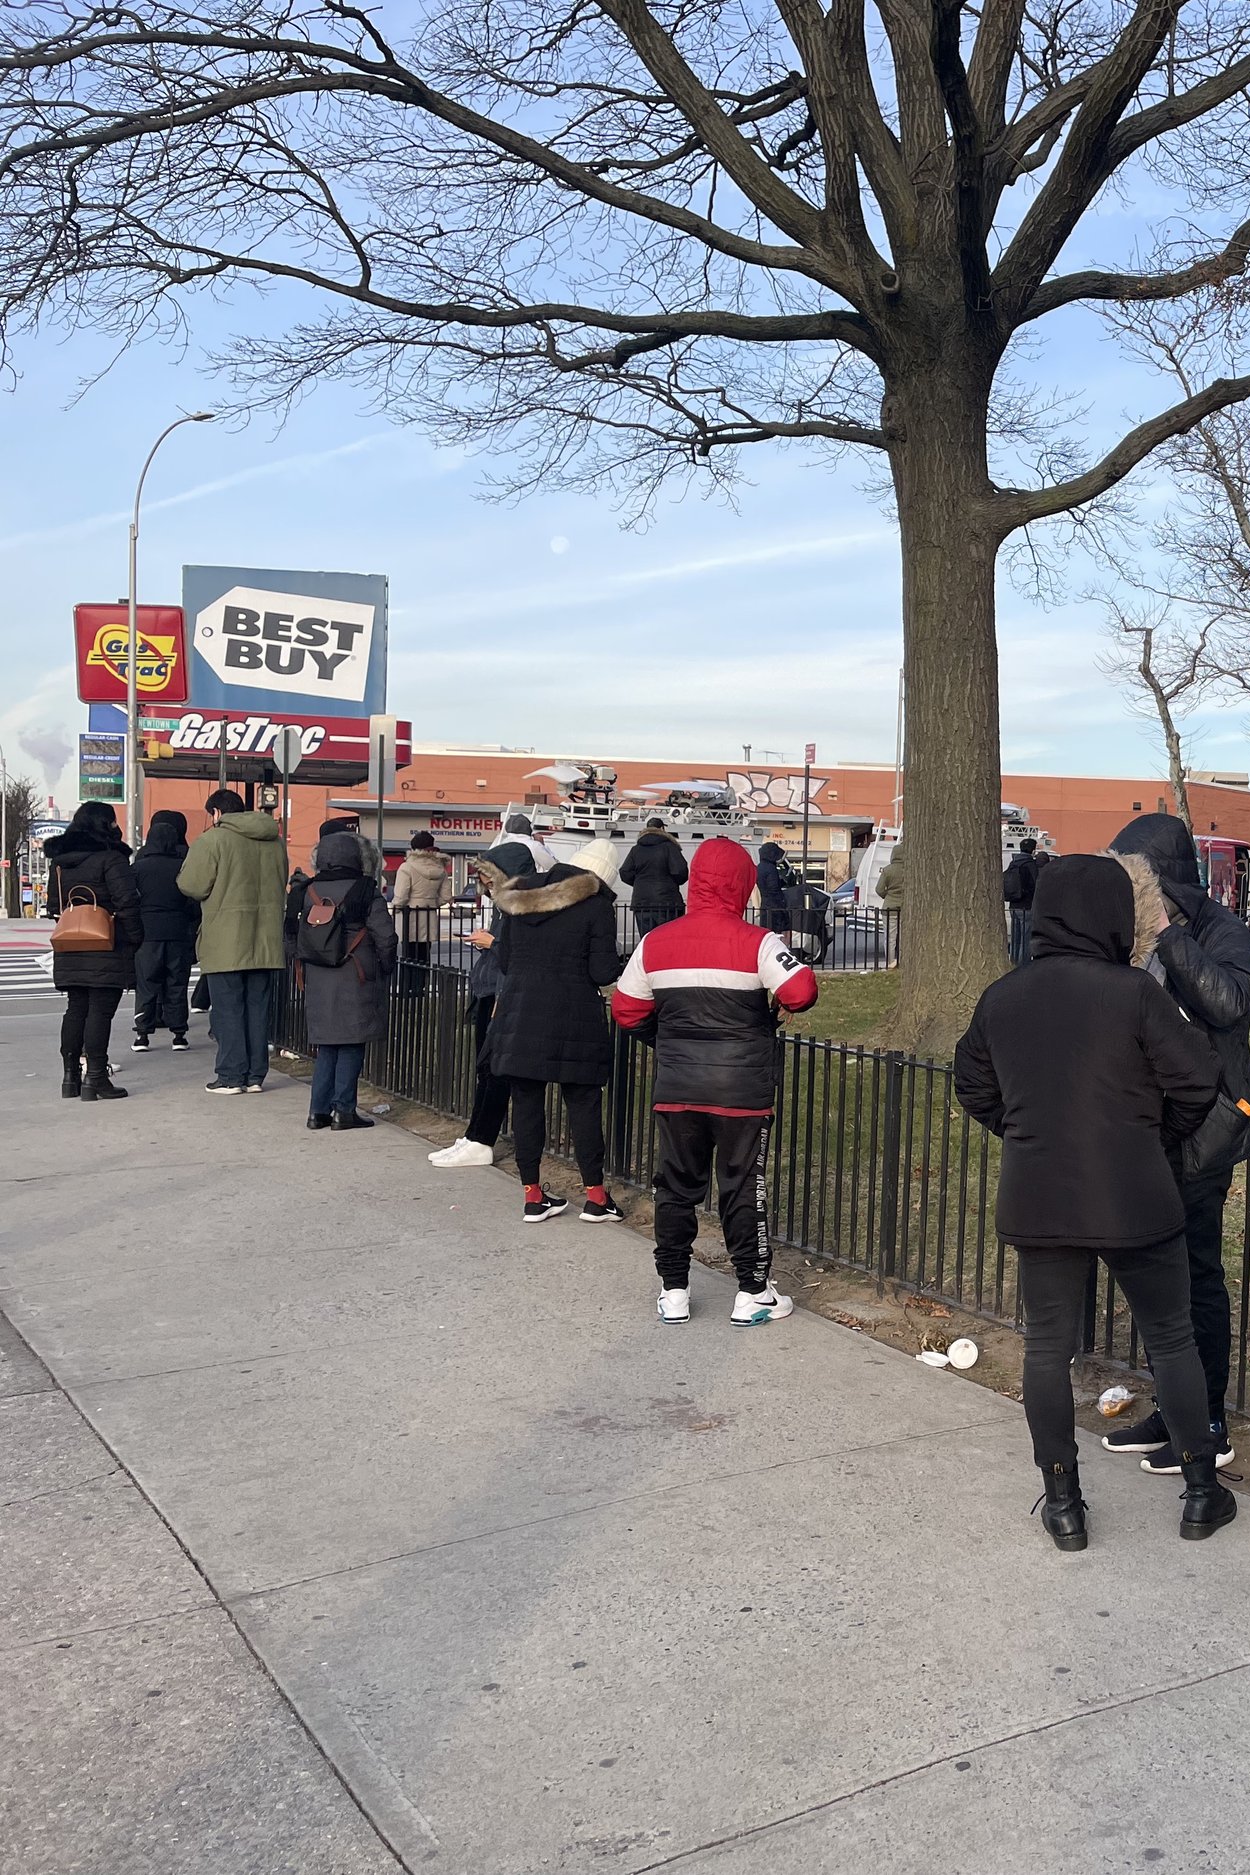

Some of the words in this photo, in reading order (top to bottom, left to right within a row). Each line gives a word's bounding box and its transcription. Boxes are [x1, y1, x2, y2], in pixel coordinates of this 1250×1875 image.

[222, 605, 364, 652] BEST
[225, 638, 350, 681] BUY
[138, 718, 170, 730] NEWTOWN
[169, 713, 326, 756] GasTrc
